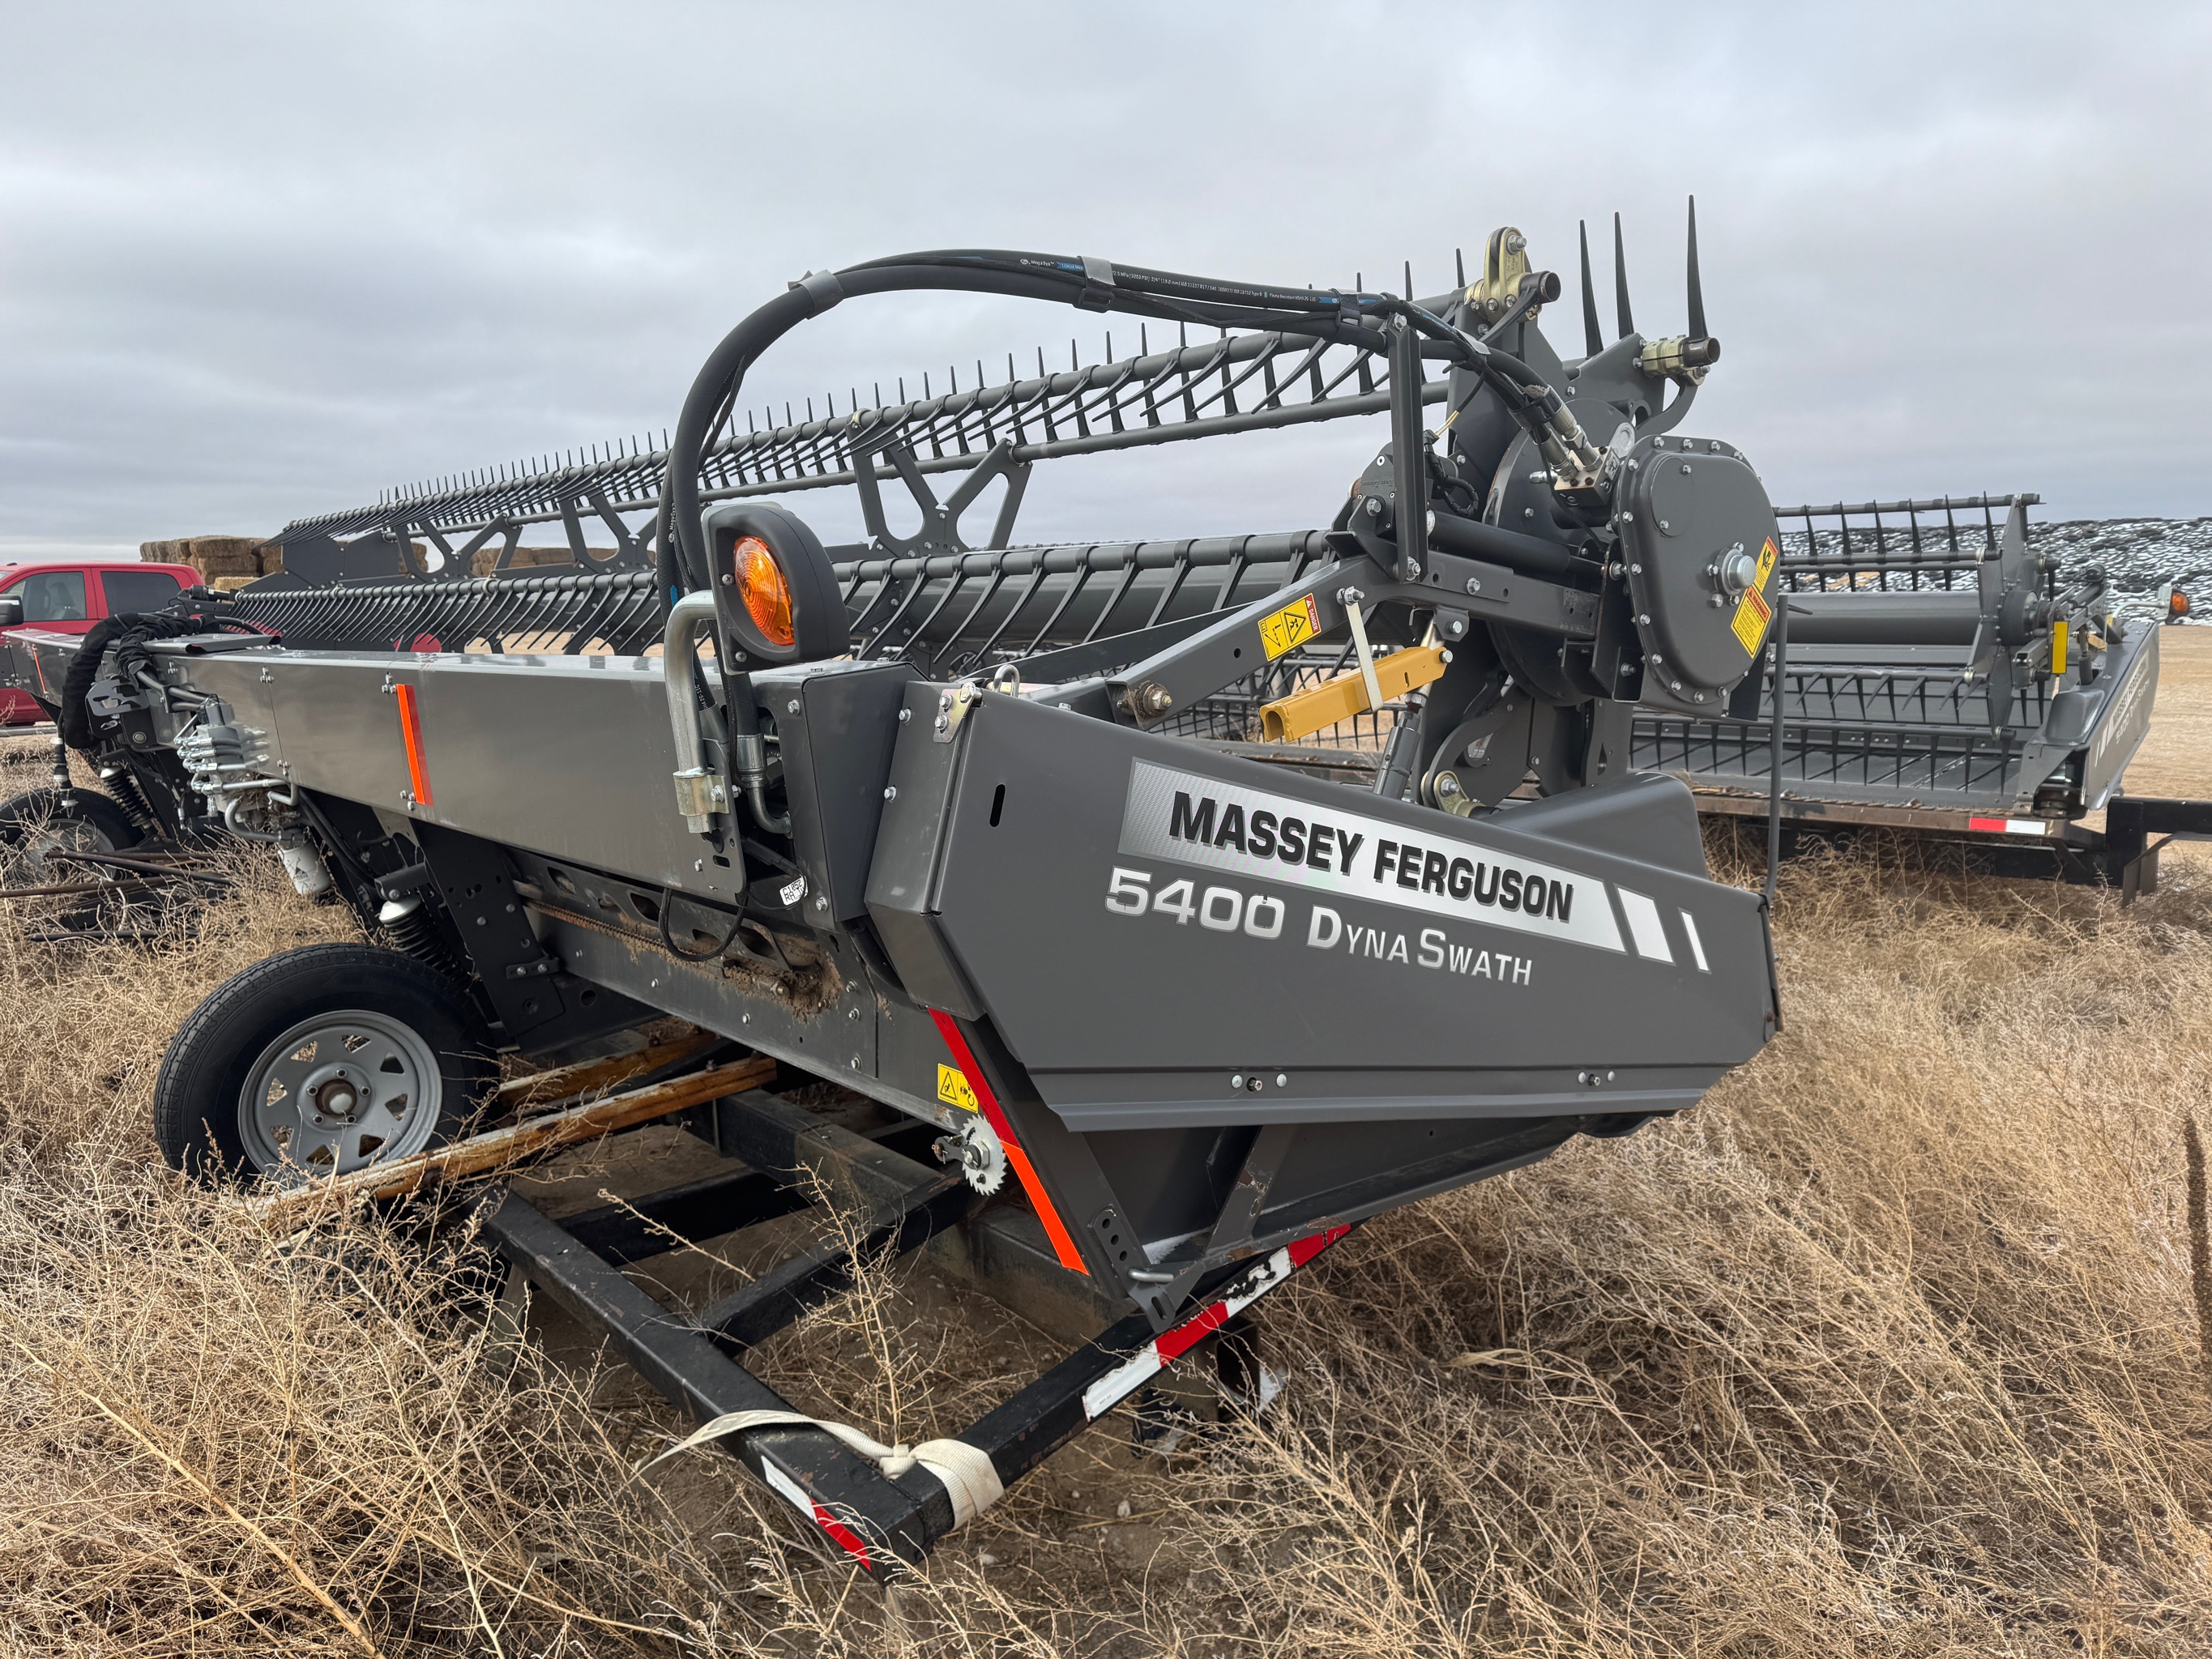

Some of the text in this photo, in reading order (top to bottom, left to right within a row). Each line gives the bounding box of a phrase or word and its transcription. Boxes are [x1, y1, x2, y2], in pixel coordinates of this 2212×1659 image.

[1309, 608, 1318, 631] DANGER
[1752, 594, 1767, 618] WARNING
[1168, 791, 1574, 923] MASSEY FERGUSON
[1104, 865, 1287, 940] 5400
